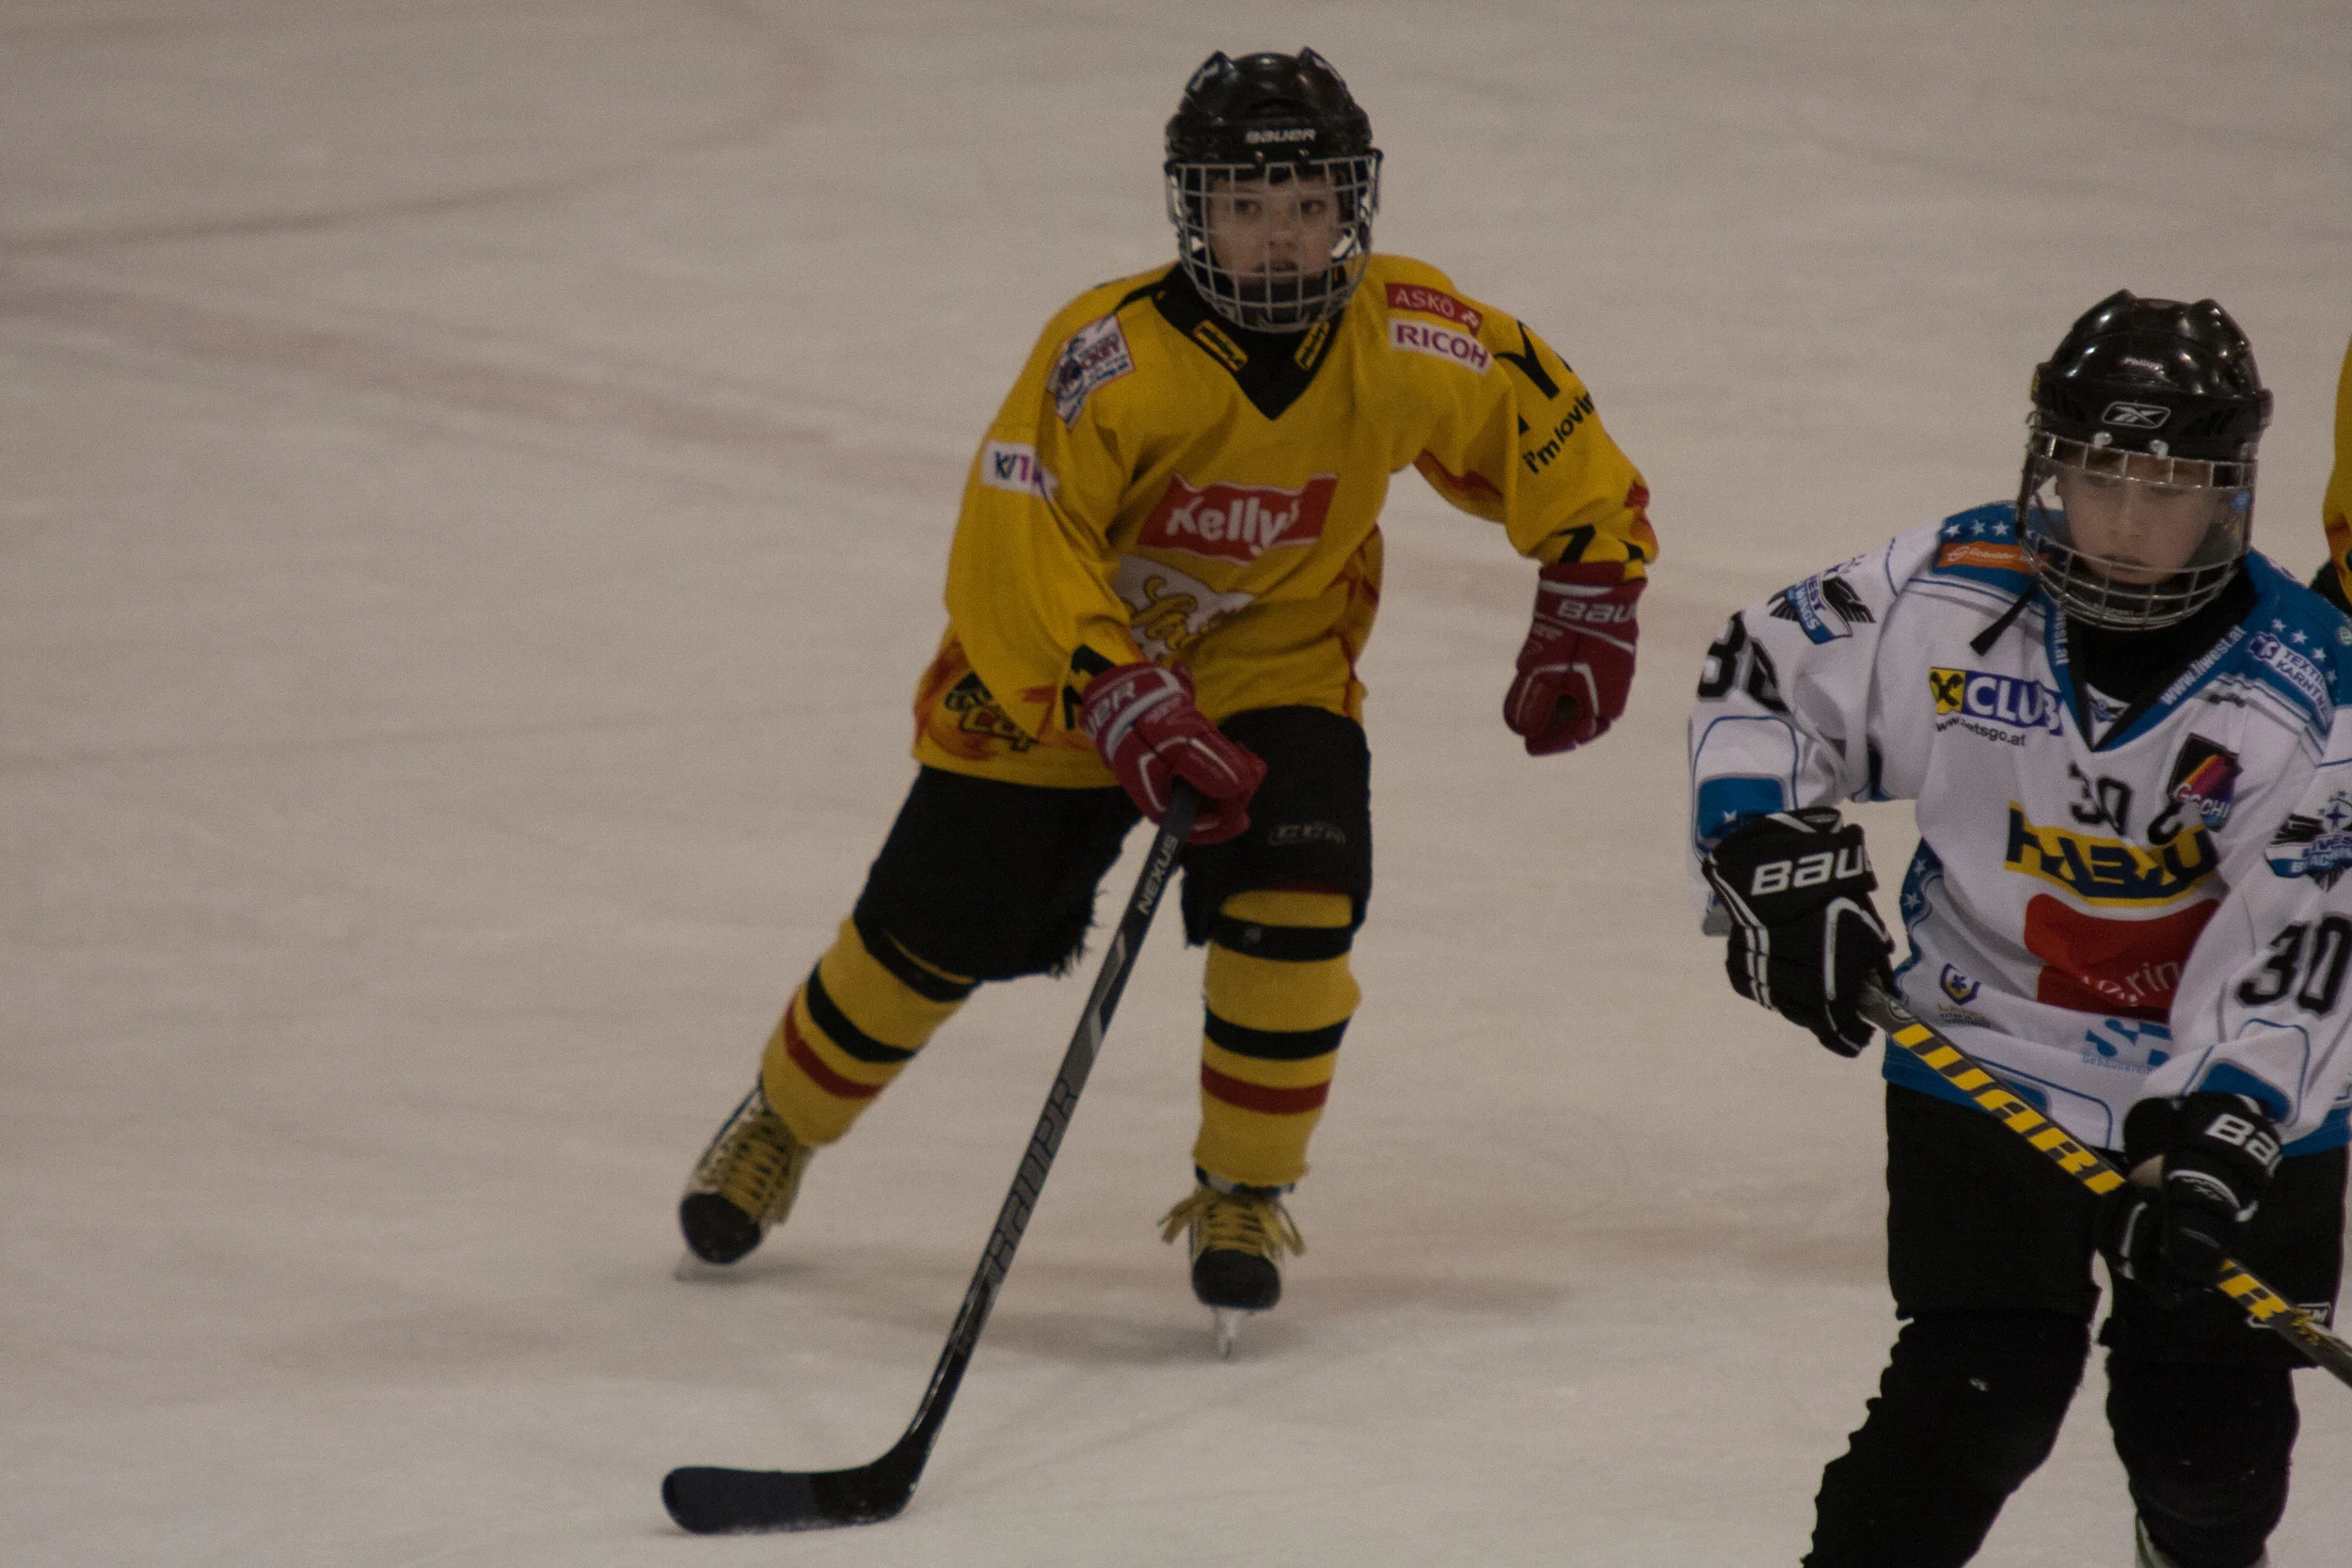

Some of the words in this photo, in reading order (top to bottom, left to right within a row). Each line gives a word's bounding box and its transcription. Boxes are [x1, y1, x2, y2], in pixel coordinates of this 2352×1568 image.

[1394, 287, 1455, 319] ASKO
[1396, 324, 1488, 369] RICOH
[1136, 832, 1180, 915] NEXUS
[2233, 912, 2352, 1016] 30
